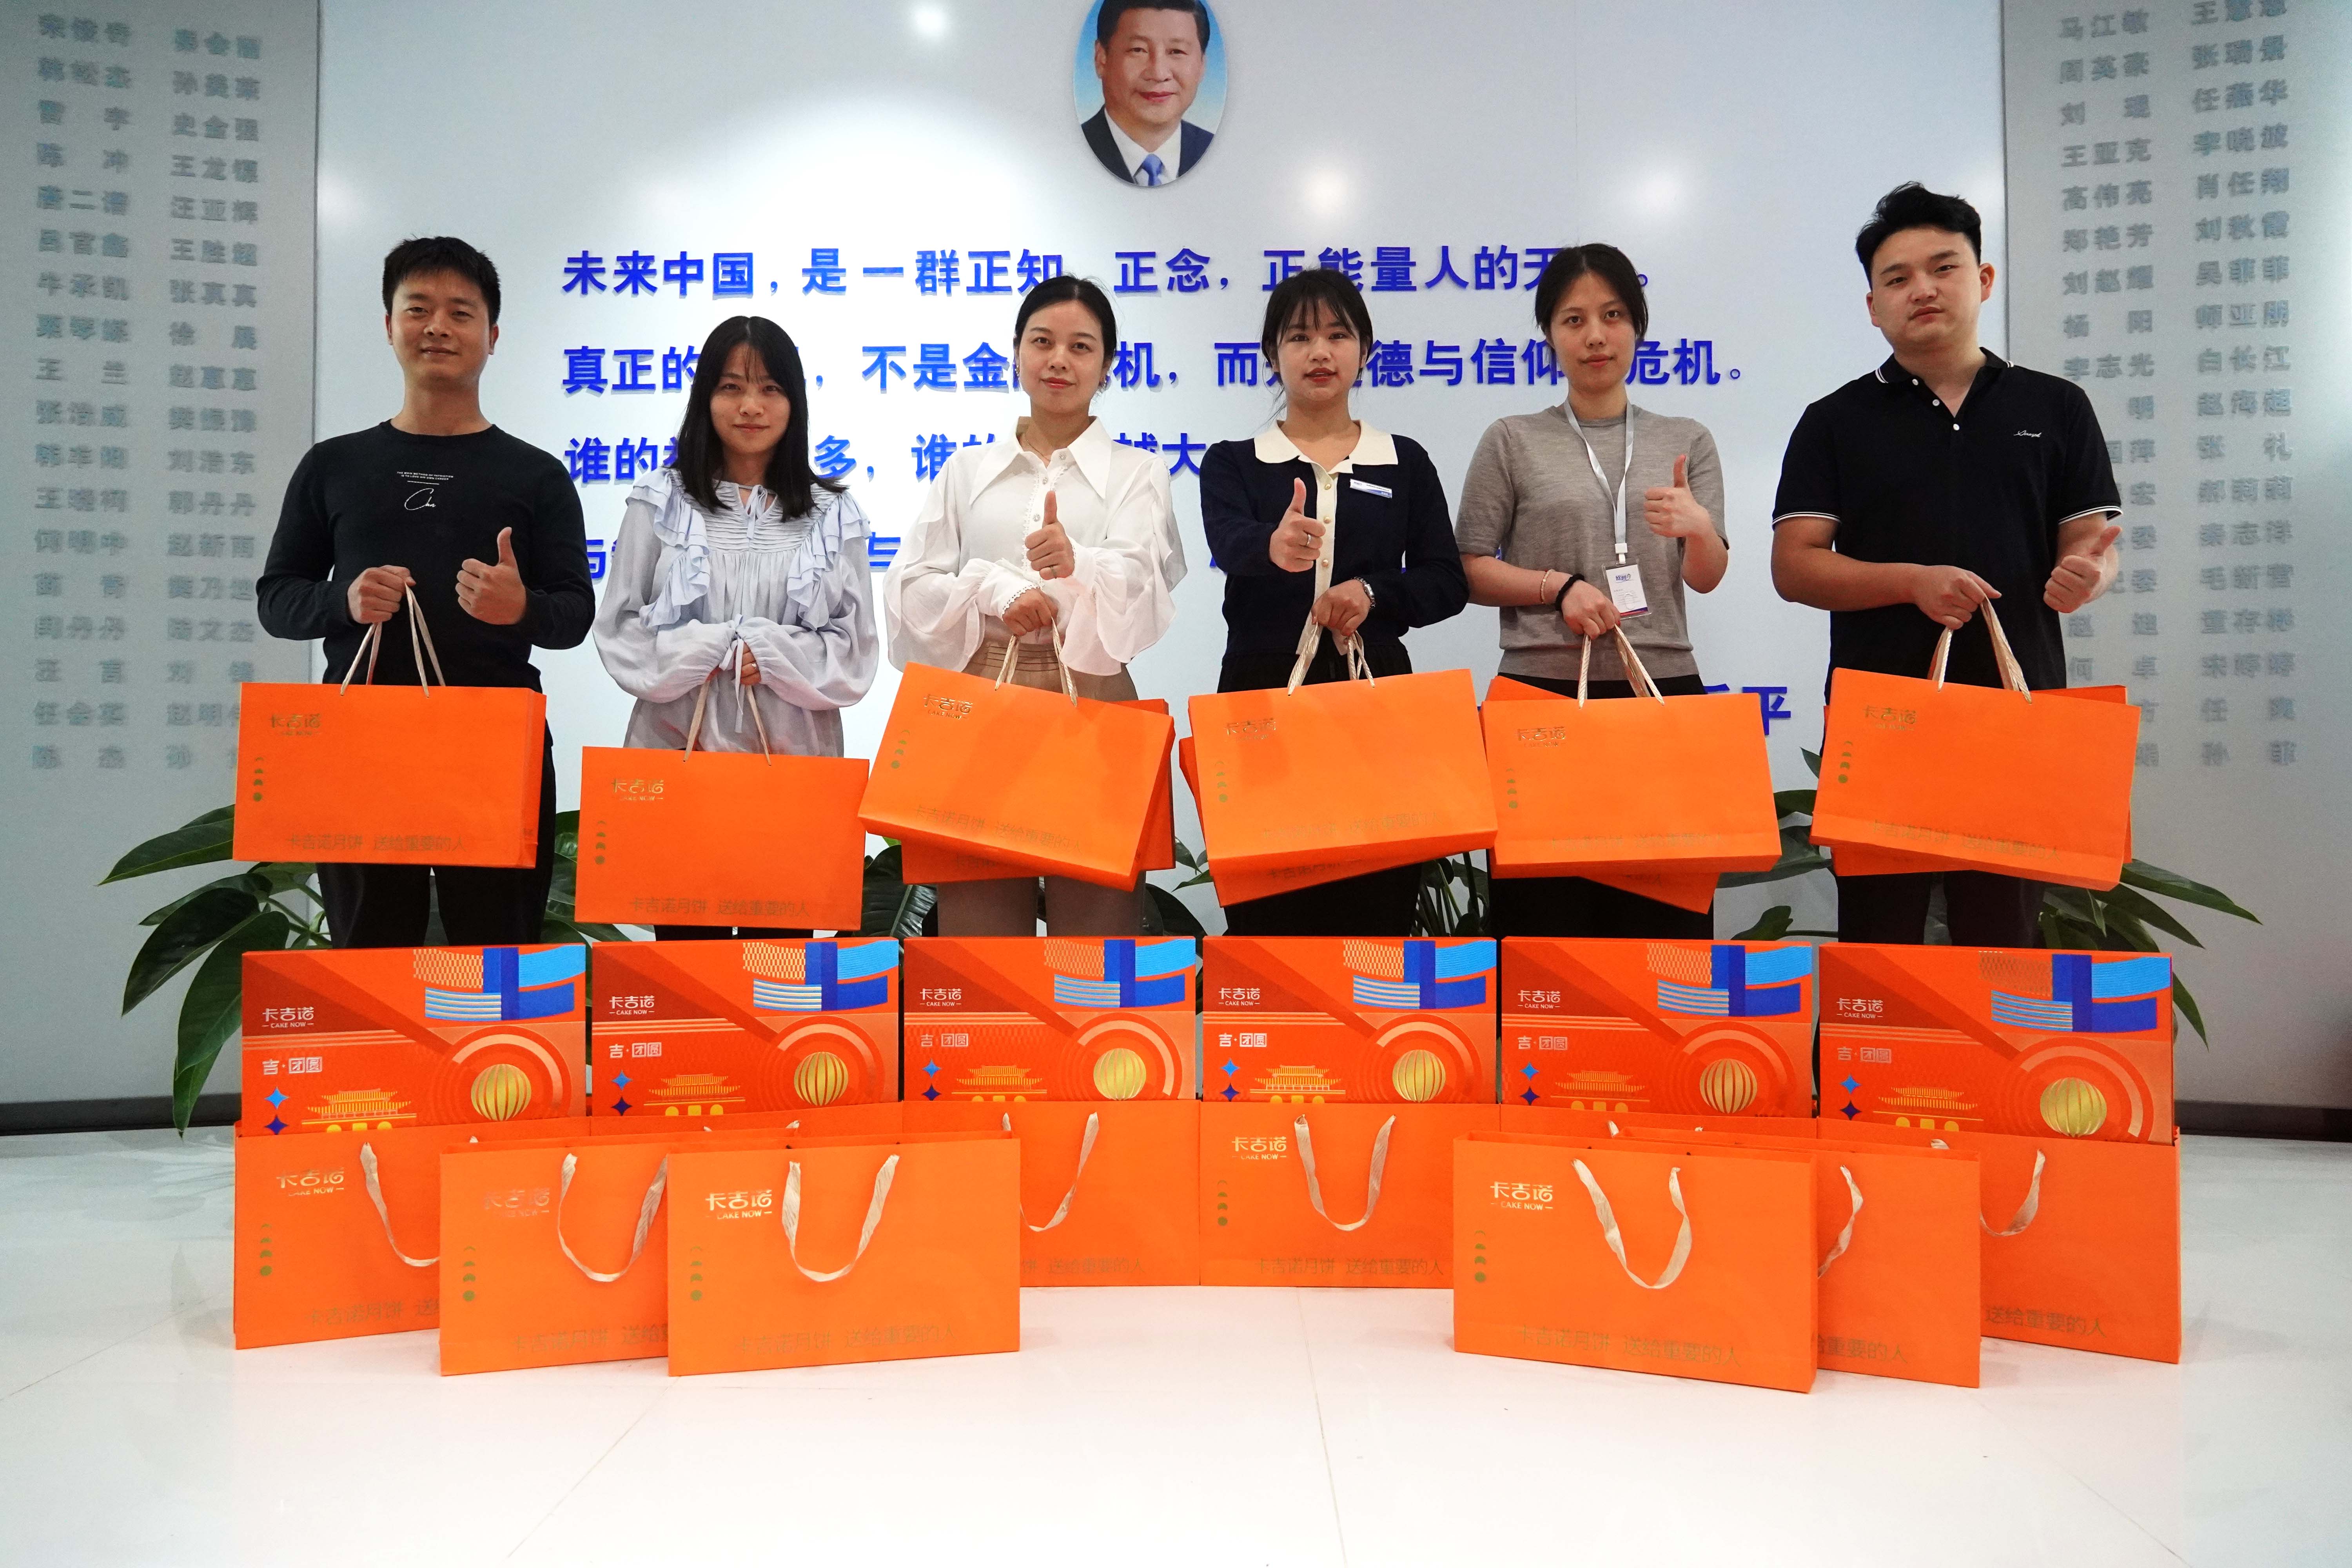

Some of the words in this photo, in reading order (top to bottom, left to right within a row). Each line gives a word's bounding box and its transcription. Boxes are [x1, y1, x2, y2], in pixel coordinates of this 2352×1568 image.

[2196, 345, 2290, 375] 白长江
[919, 988, 962, 1001] 卡吉诺
[1218, 987, 1261, 1000] 卡吉诺
[1517, 989, 1561, 1003] 卡吉诺
[609, 995, 655, 1009] 卡吉诺
[1836, 998, 1884, 1013] 卡吉诺
[262, 1007, 314, 1022] 卡吉诺
[1231, 1136, 1287, 1152] 卡吉诺
[1490, 1181, 1553, 1202] 卡吉诺
[705, 1189, 773, 1211] 卡吉诺
